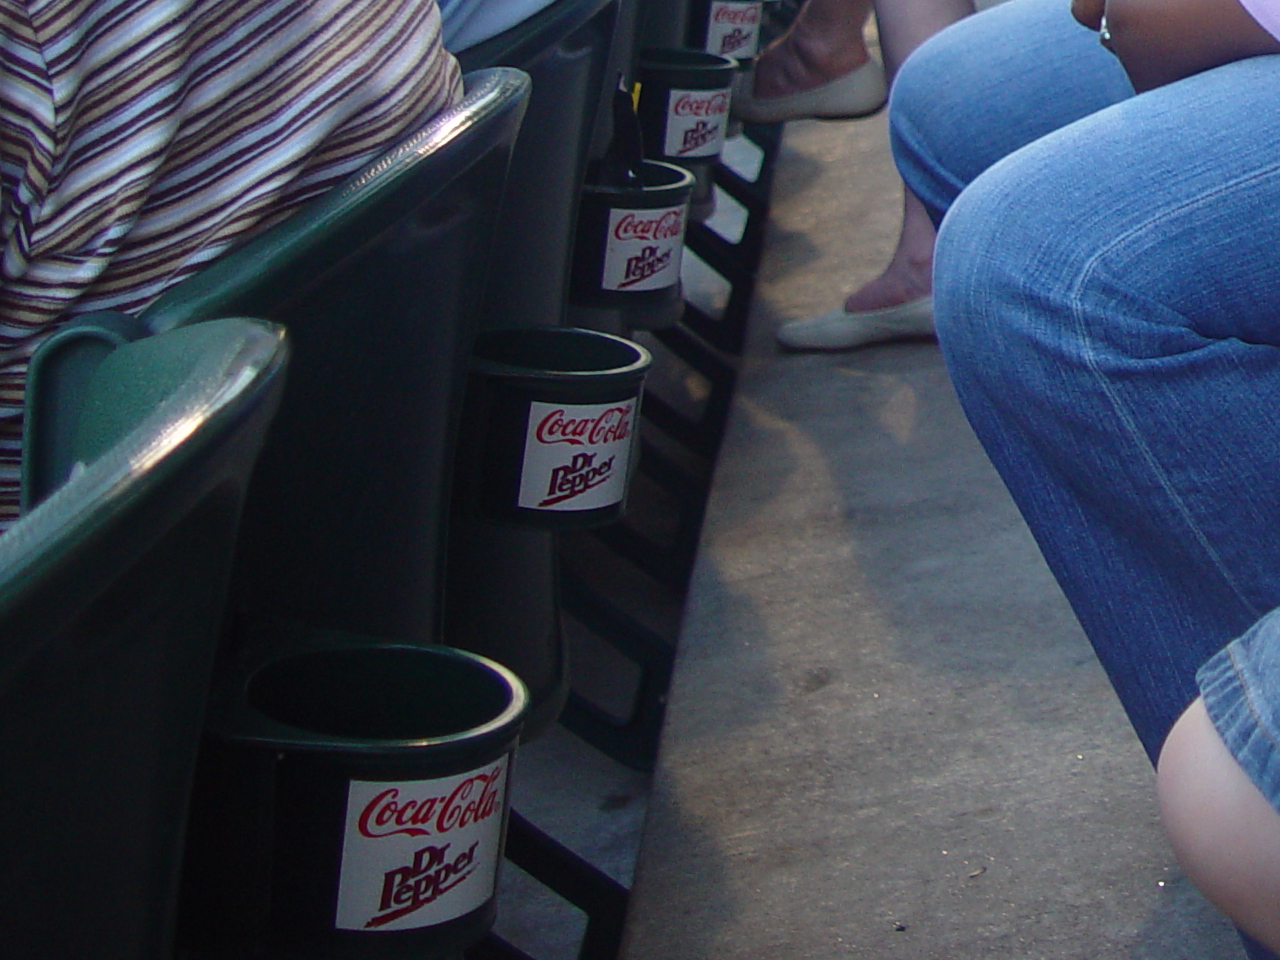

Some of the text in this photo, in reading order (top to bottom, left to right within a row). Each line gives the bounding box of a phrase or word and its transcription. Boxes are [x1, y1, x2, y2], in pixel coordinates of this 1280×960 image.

[614, 211, 683, 241] Coca-Cola
[625, 248, 672, 281] Pepper
[536, 405, 632, 445] Coca-Cola
[547, 455, 615, 496] Pepper
[571, 452, 597, 474] Dr
[358, 767, 501, 838] Coca-Cola
[378, 841, 480, 912] Pepper
[413, 843, 451, 874] Dr
